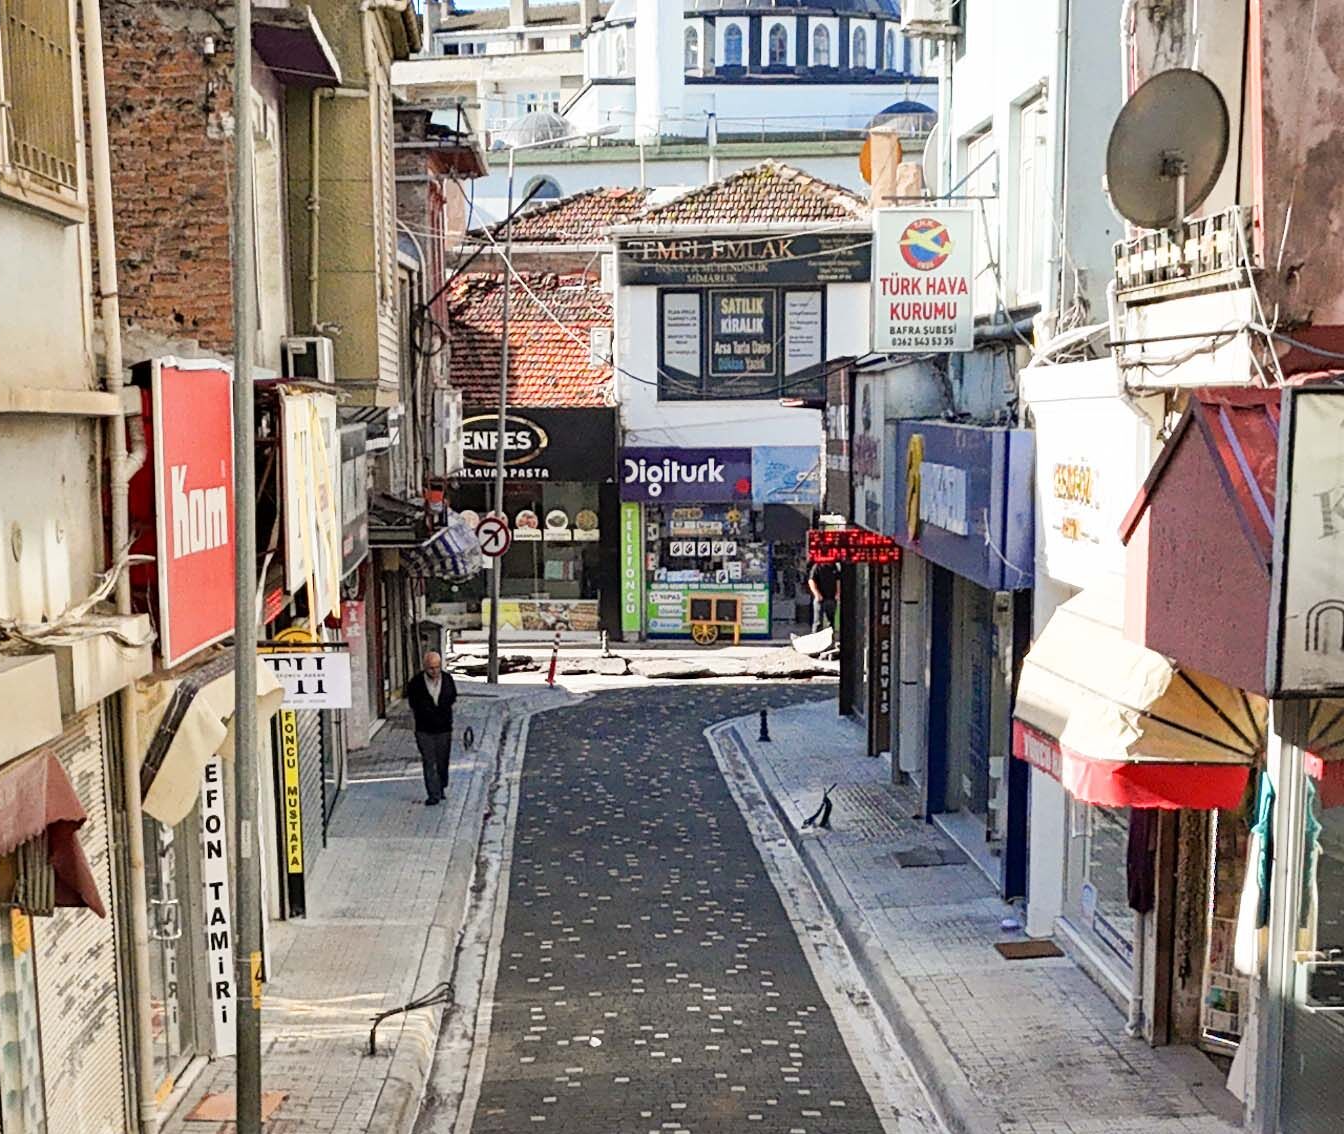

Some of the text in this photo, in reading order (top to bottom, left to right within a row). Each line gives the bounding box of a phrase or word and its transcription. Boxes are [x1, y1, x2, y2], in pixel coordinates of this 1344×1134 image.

[627, 239, 706, 260] TEMEL
[711, 239, 795, 260] EMLAK
[880, 272, 922, 296] TÜRK
[926, 277, 968, 295] HAVA
[720, 297, 764, 314] SATILIK
[890, 302, 957, 320] KURUMU
[720, 315, 764, 333] KİRALIK
[889, 326, 920, 335] BAFRA
[510, 468, 549, 478] PASTA
[624, 457, 724, 496] Digiturk
[624, 509, 636, 614] TELEFONCU
[287, 786, 300, 866] MUSTAFA
